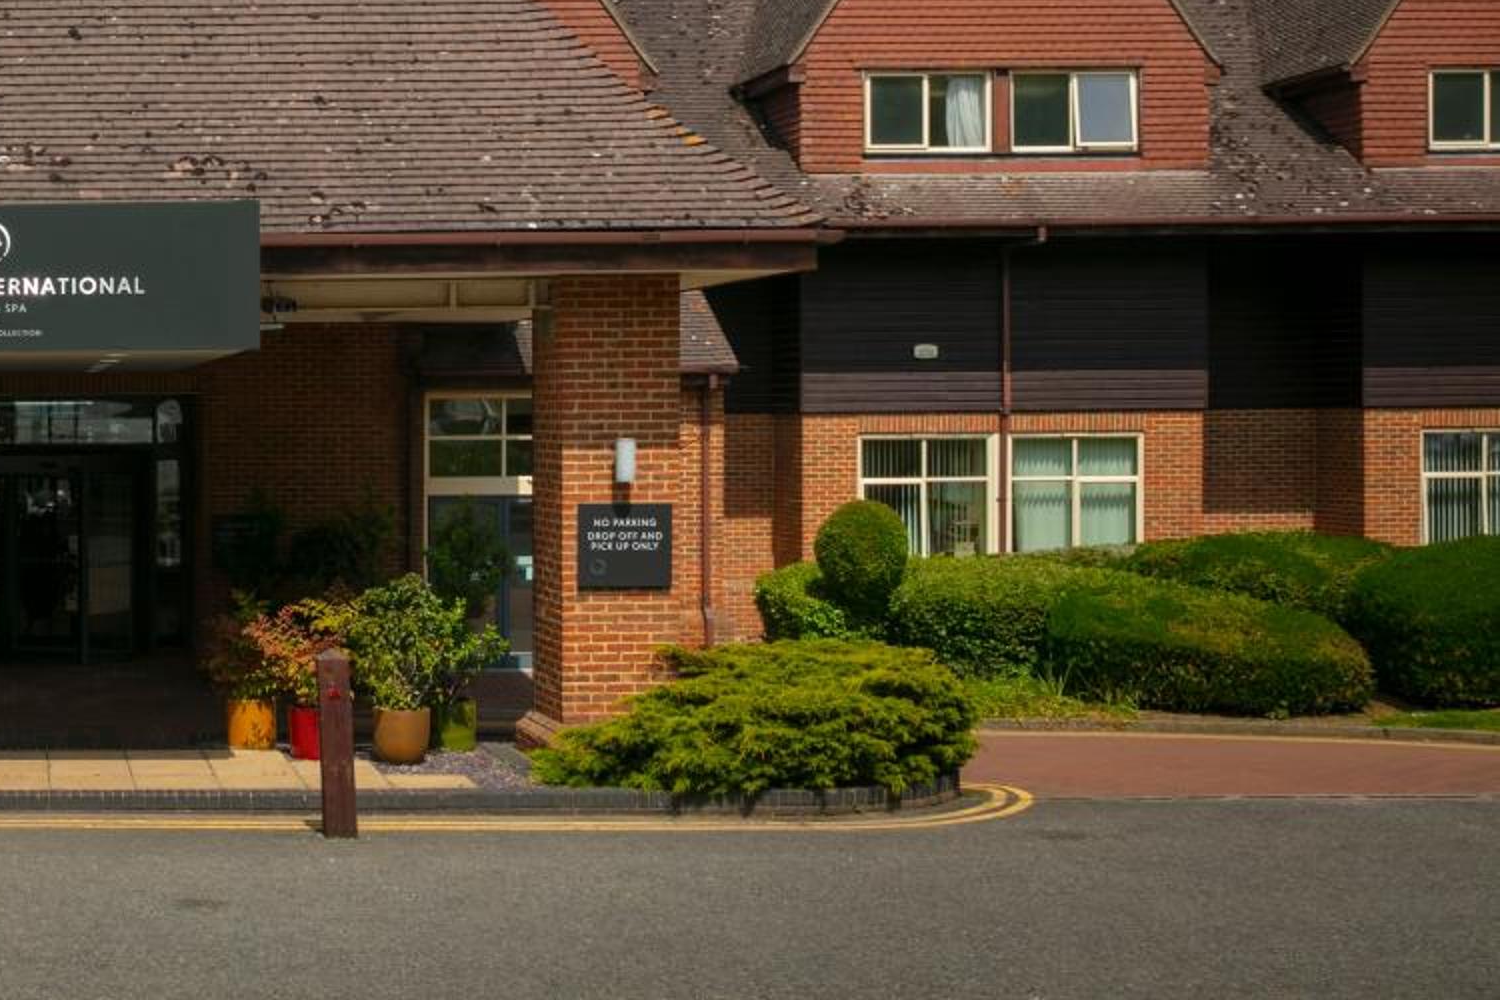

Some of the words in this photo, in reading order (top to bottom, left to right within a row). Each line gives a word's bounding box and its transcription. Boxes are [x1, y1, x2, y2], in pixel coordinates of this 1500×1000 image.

[5, 303, 27, 313] SPA
[593, 517, 610, 527] NO
[613, 517, 657, 527] PARKING
[587, 531, 616, 541] DROP
[617, 531, 639, 541] OFF
[640, 531, 663, 541] AND
[590, 541, 613, 551] PICK
[615, 541, 630, 551] UP
[631, 541, 659, 551] ONLY
